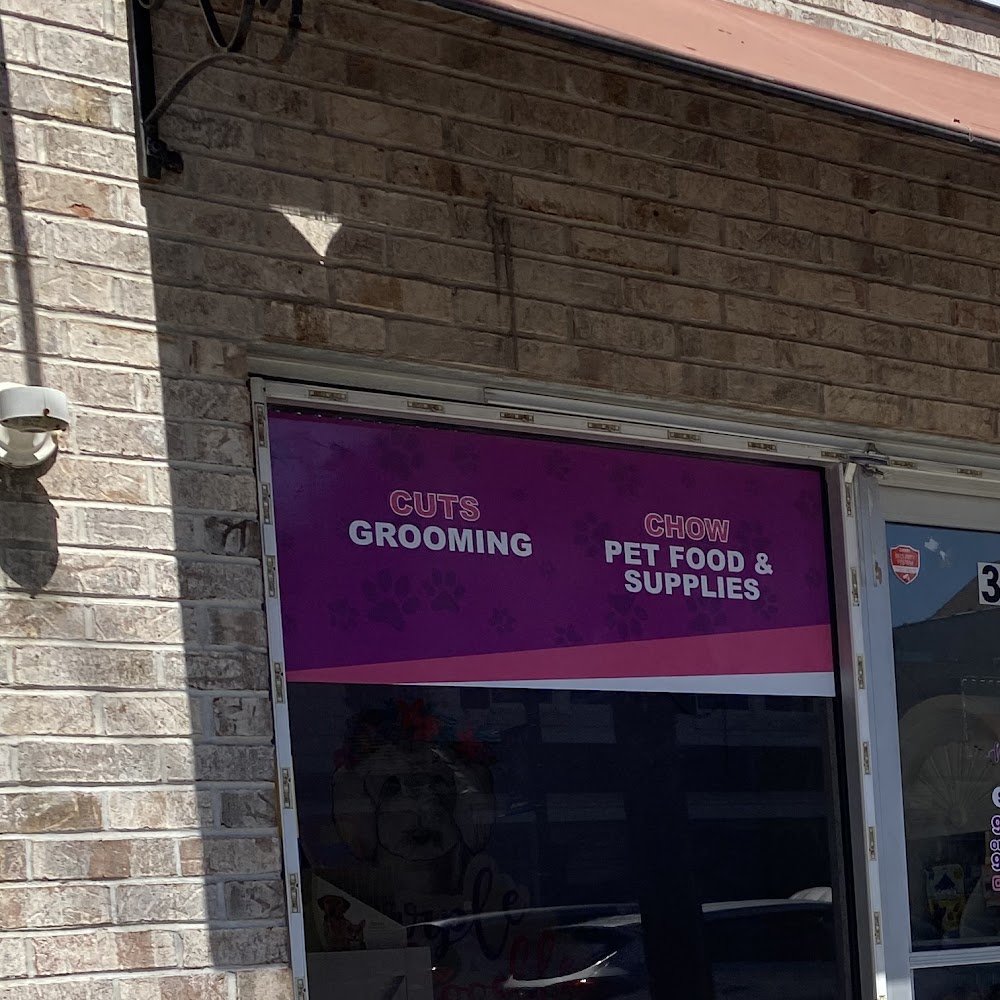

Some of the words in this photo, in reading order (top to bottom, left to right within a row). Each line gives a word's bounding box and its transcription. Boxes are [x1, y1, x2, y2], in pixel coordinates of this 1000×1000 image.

[389, 489, 481, 522] CUTS
[348, 519, 533, 558] GROOMING
[643, 512, 730, 544] CHOW
[604, 539, 659, 566] PET
[670, 545, 745, 574] FOOD
[754, 552, 774, 576] &
[624, 569, 761, 601] SUPPLIES
